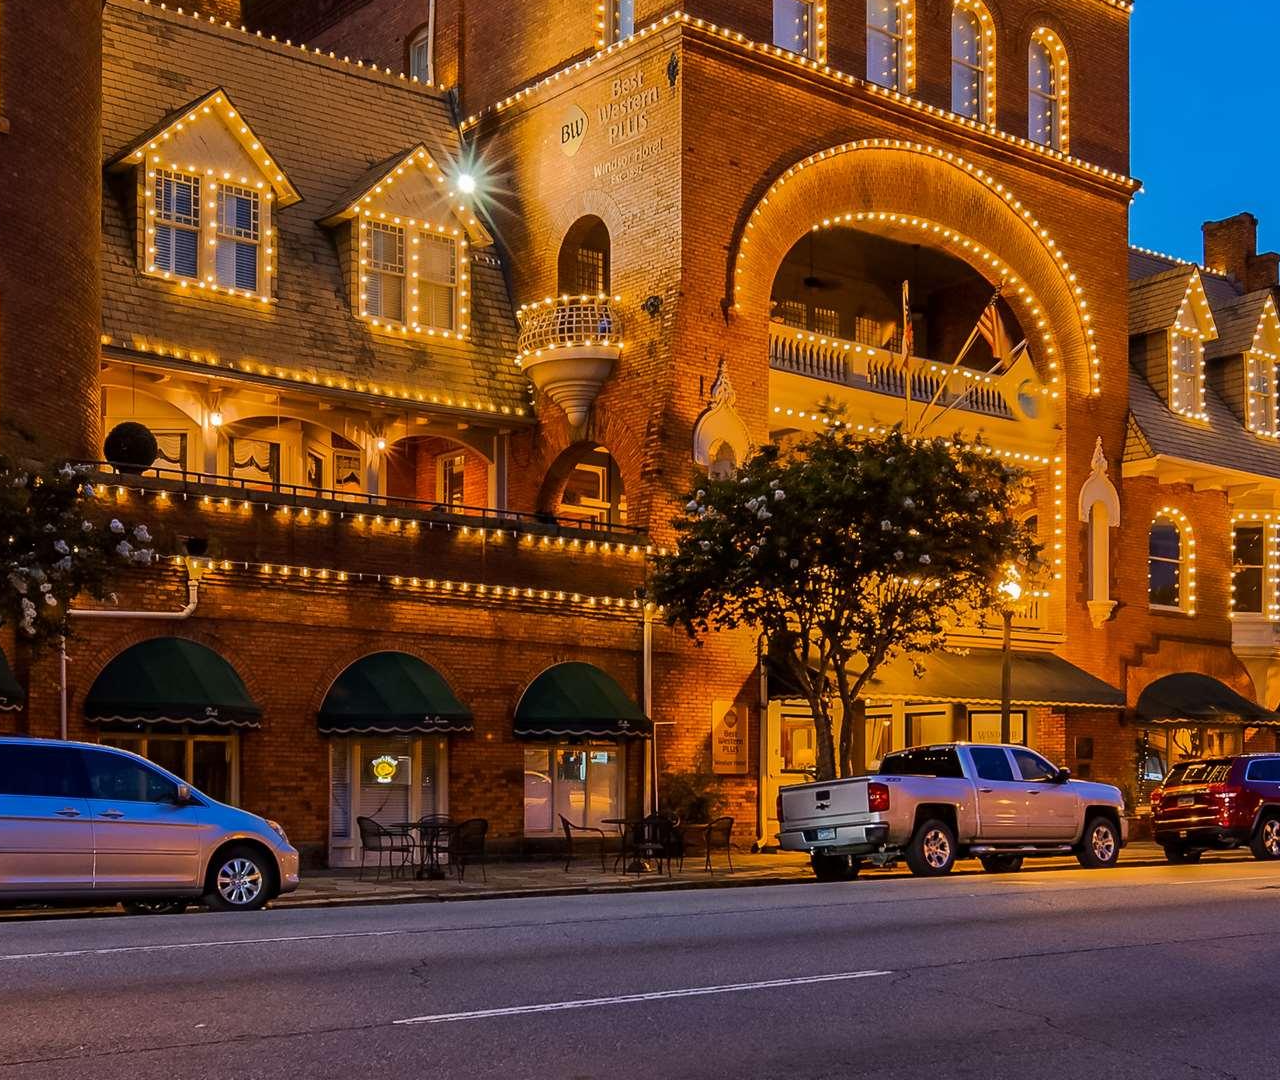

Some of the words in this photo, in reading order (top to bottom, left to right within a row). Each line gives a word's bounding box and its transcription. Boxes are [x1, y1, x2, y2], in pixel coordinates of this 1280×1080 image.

[612, 70, 645, 98] Best
[597, 87, 659, 123] Western
[561, 118, 584, 144] BW
[609, 111, 649, 144] PLUS
